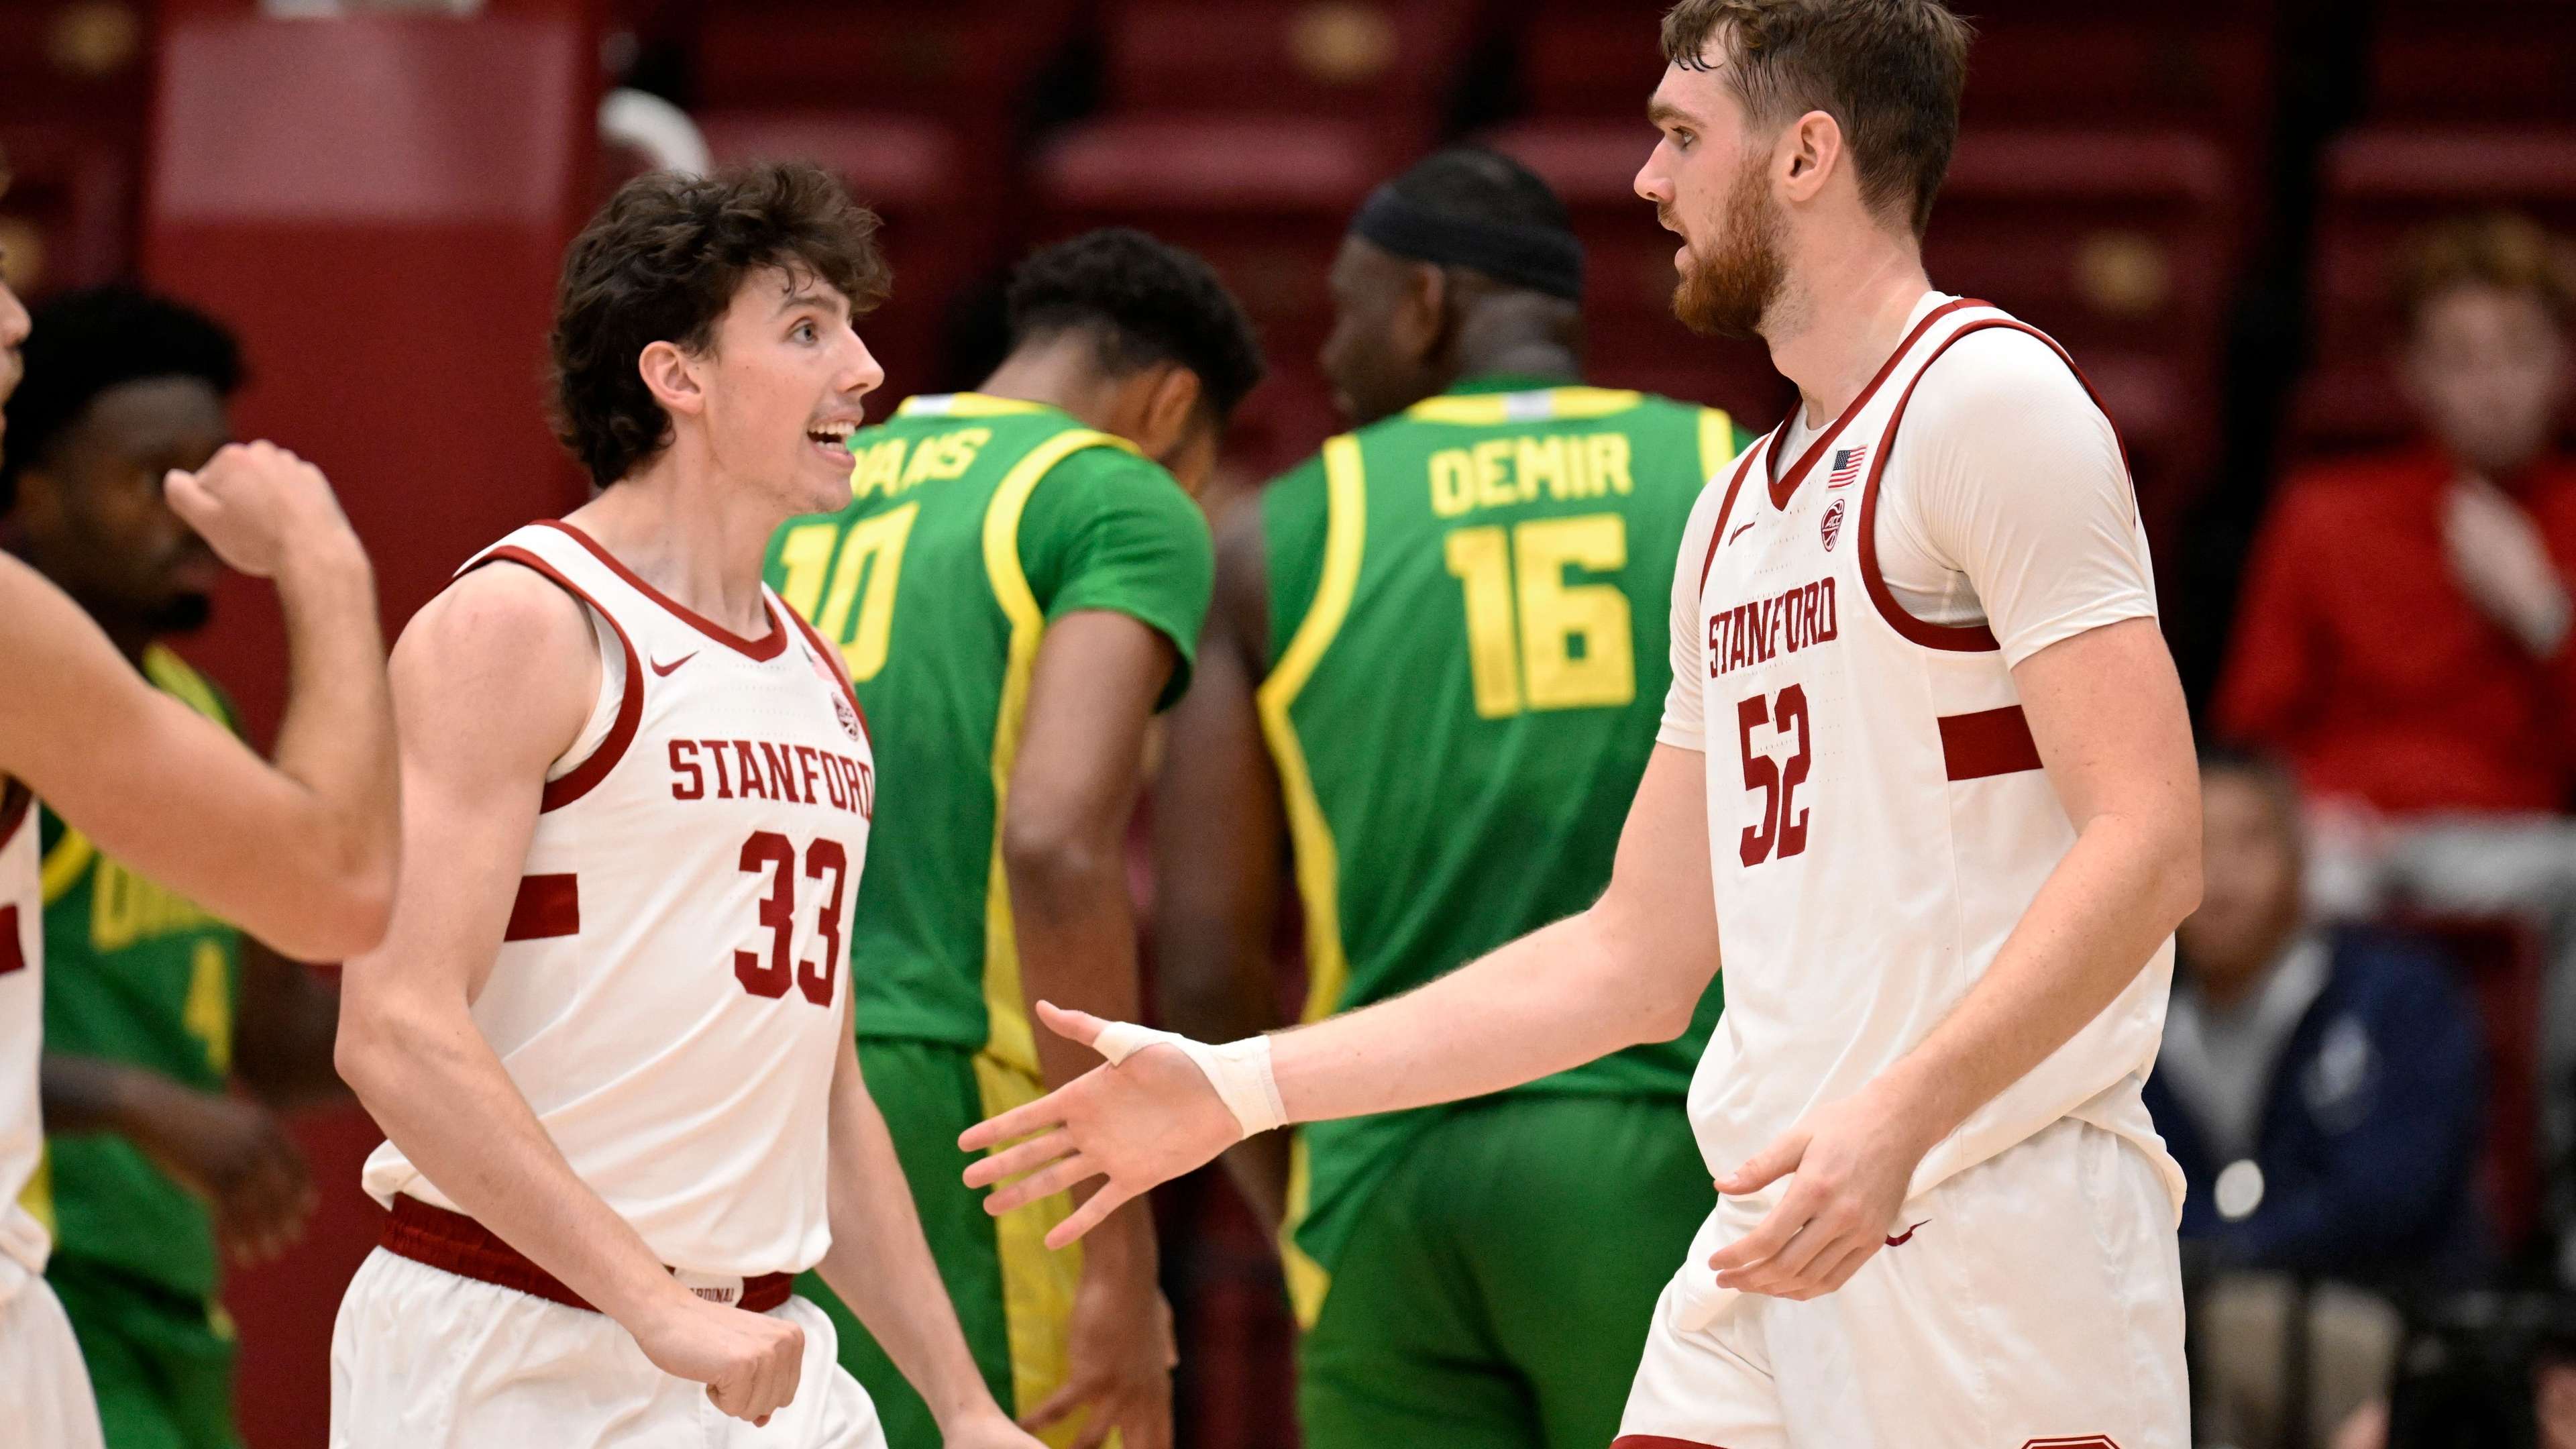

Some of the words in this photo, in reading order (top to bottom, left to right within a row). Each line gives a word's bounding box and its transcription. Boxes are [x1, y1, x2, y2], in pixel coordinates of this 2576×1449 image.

[849, 427, 992, 498] VANS
[1429, 433, 1634, 519] DEMIR
[1825, 514, 1843, 527] ACC
[781, 502, 920, 682] 10
[1444, 512, 1637, 719] 16
[1709, 576, 1839, 678] STANFORD
[668, 739, 872, 823] STANFORD
[1737, 683, 1812, 867] 52
[735, 830, 847, 1008] 33
[690, 1287, 734, 1303] RDINAL
